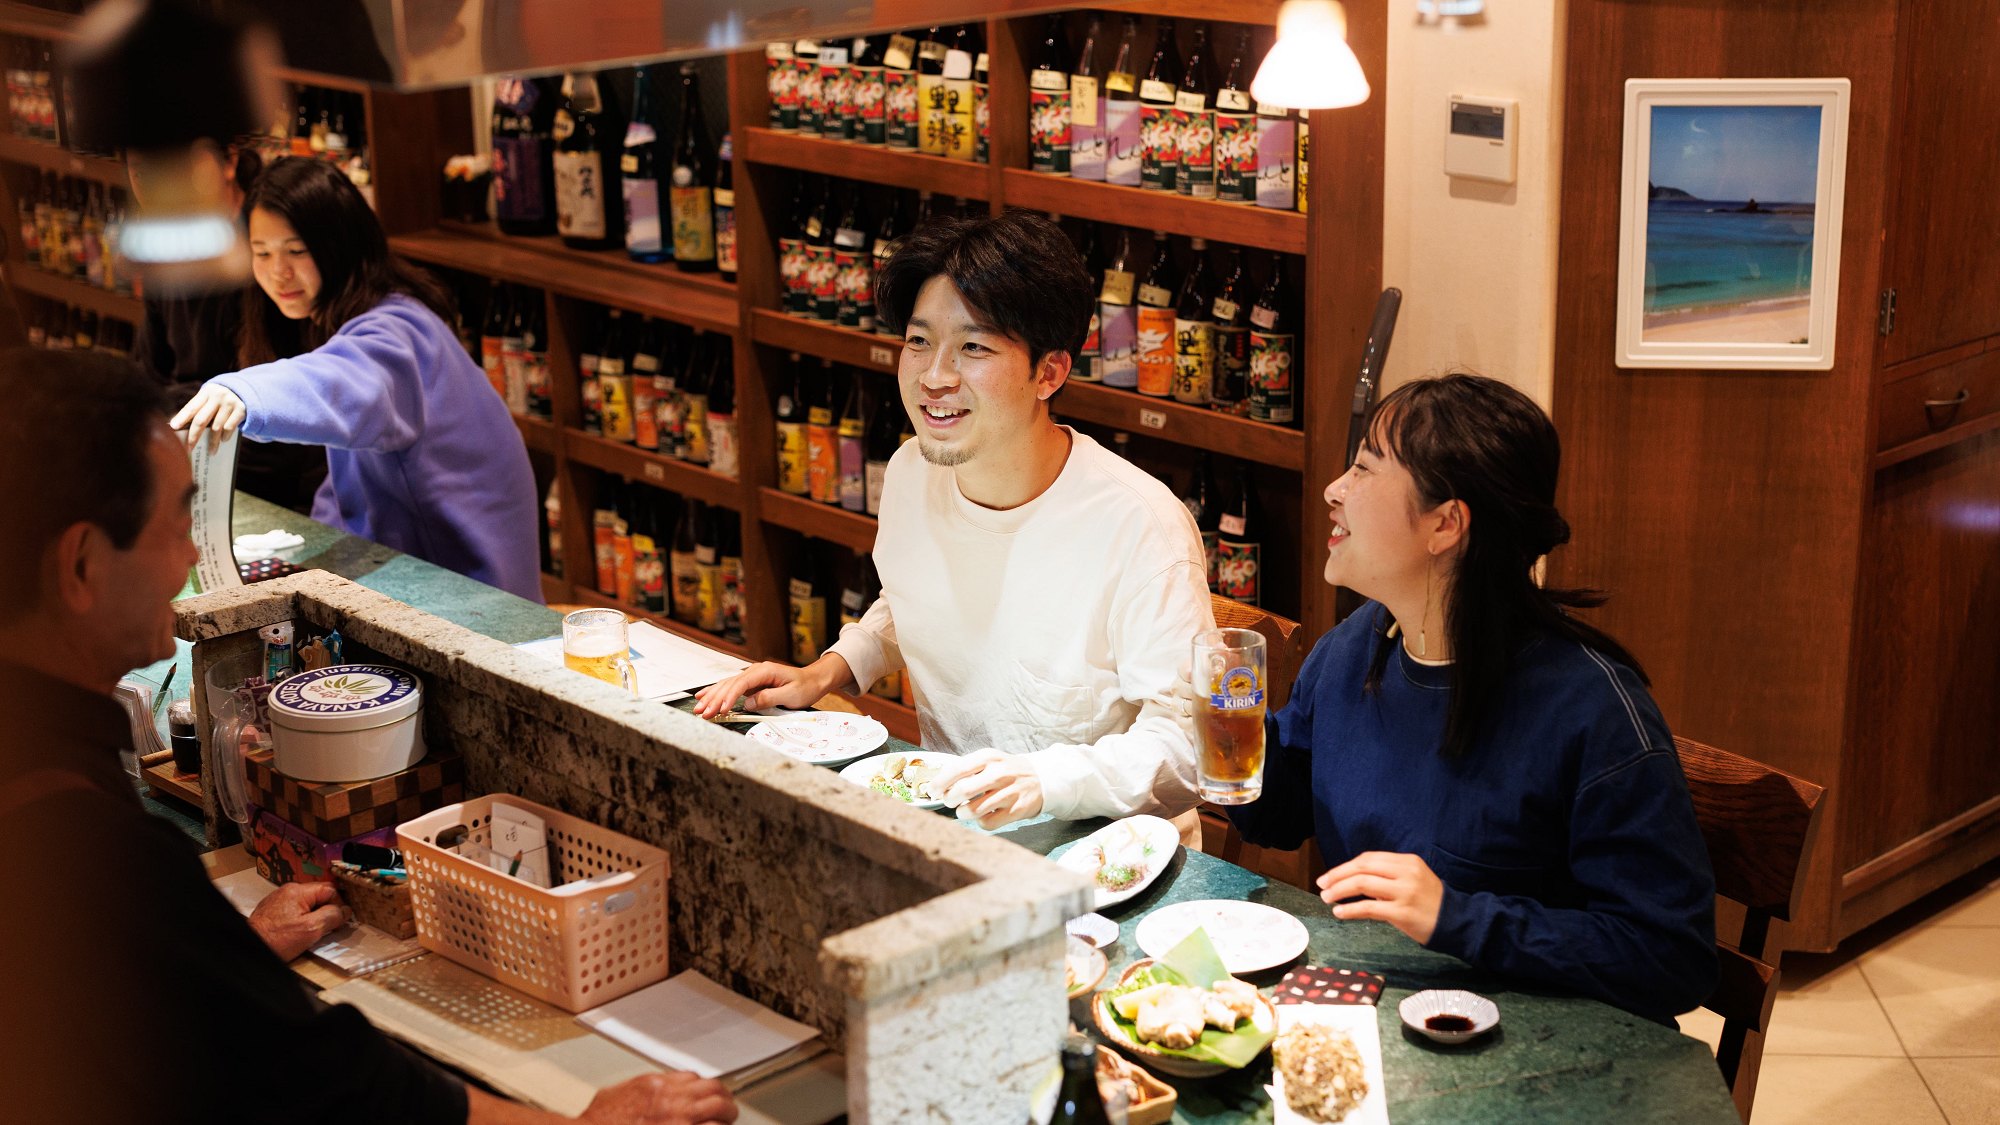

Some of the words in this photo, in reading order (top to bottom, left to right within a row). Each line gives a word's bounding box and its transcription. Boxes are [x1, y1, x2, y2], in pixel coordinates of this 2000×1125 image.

[315, 666, 395, 678] Chuzenji
[280, 682, 306, 705] HOTEL
[297, 699, 381, 712] KANAYA
[1224, 697, 1256, 709] KIRIN
